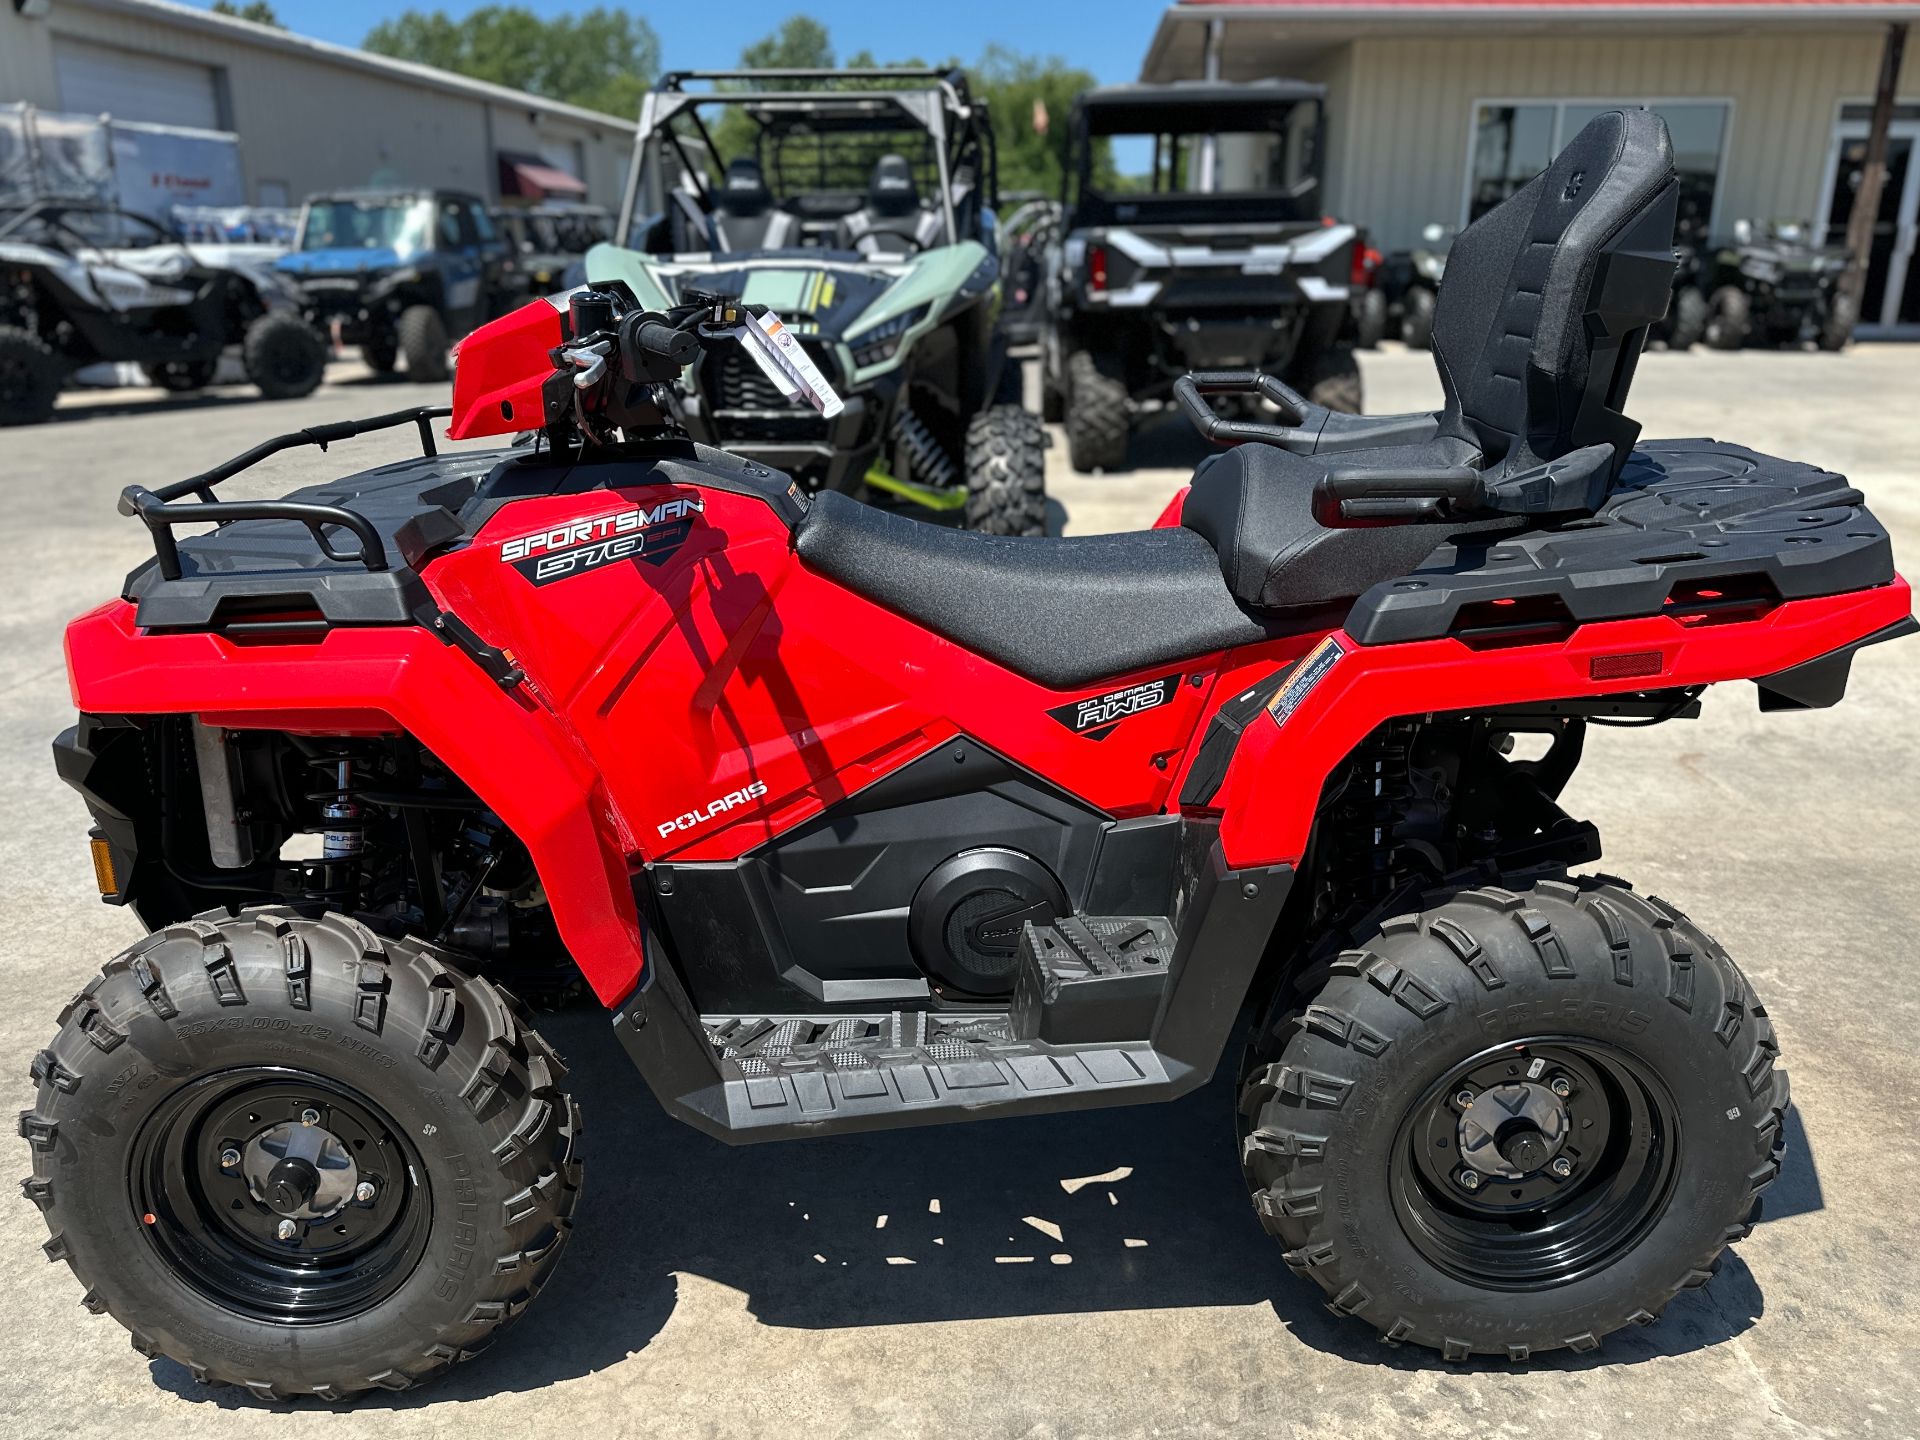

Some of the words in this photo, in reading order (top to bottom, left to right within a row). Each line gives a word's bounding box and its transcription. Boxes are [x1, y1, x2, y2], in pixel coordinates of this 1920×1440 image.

[501, 498, 704, 562] SPORTSMAN
[536, 533, 644, 580] 570
[646, 527, 681, 543] EFI
[1077, 688, 1164, 729] AWD
[1103, 680, 1164, 703] DEMAND
[657, 780, 768, 839] POLARIS
[1477, 999, 1653, 1036] POLARIS
